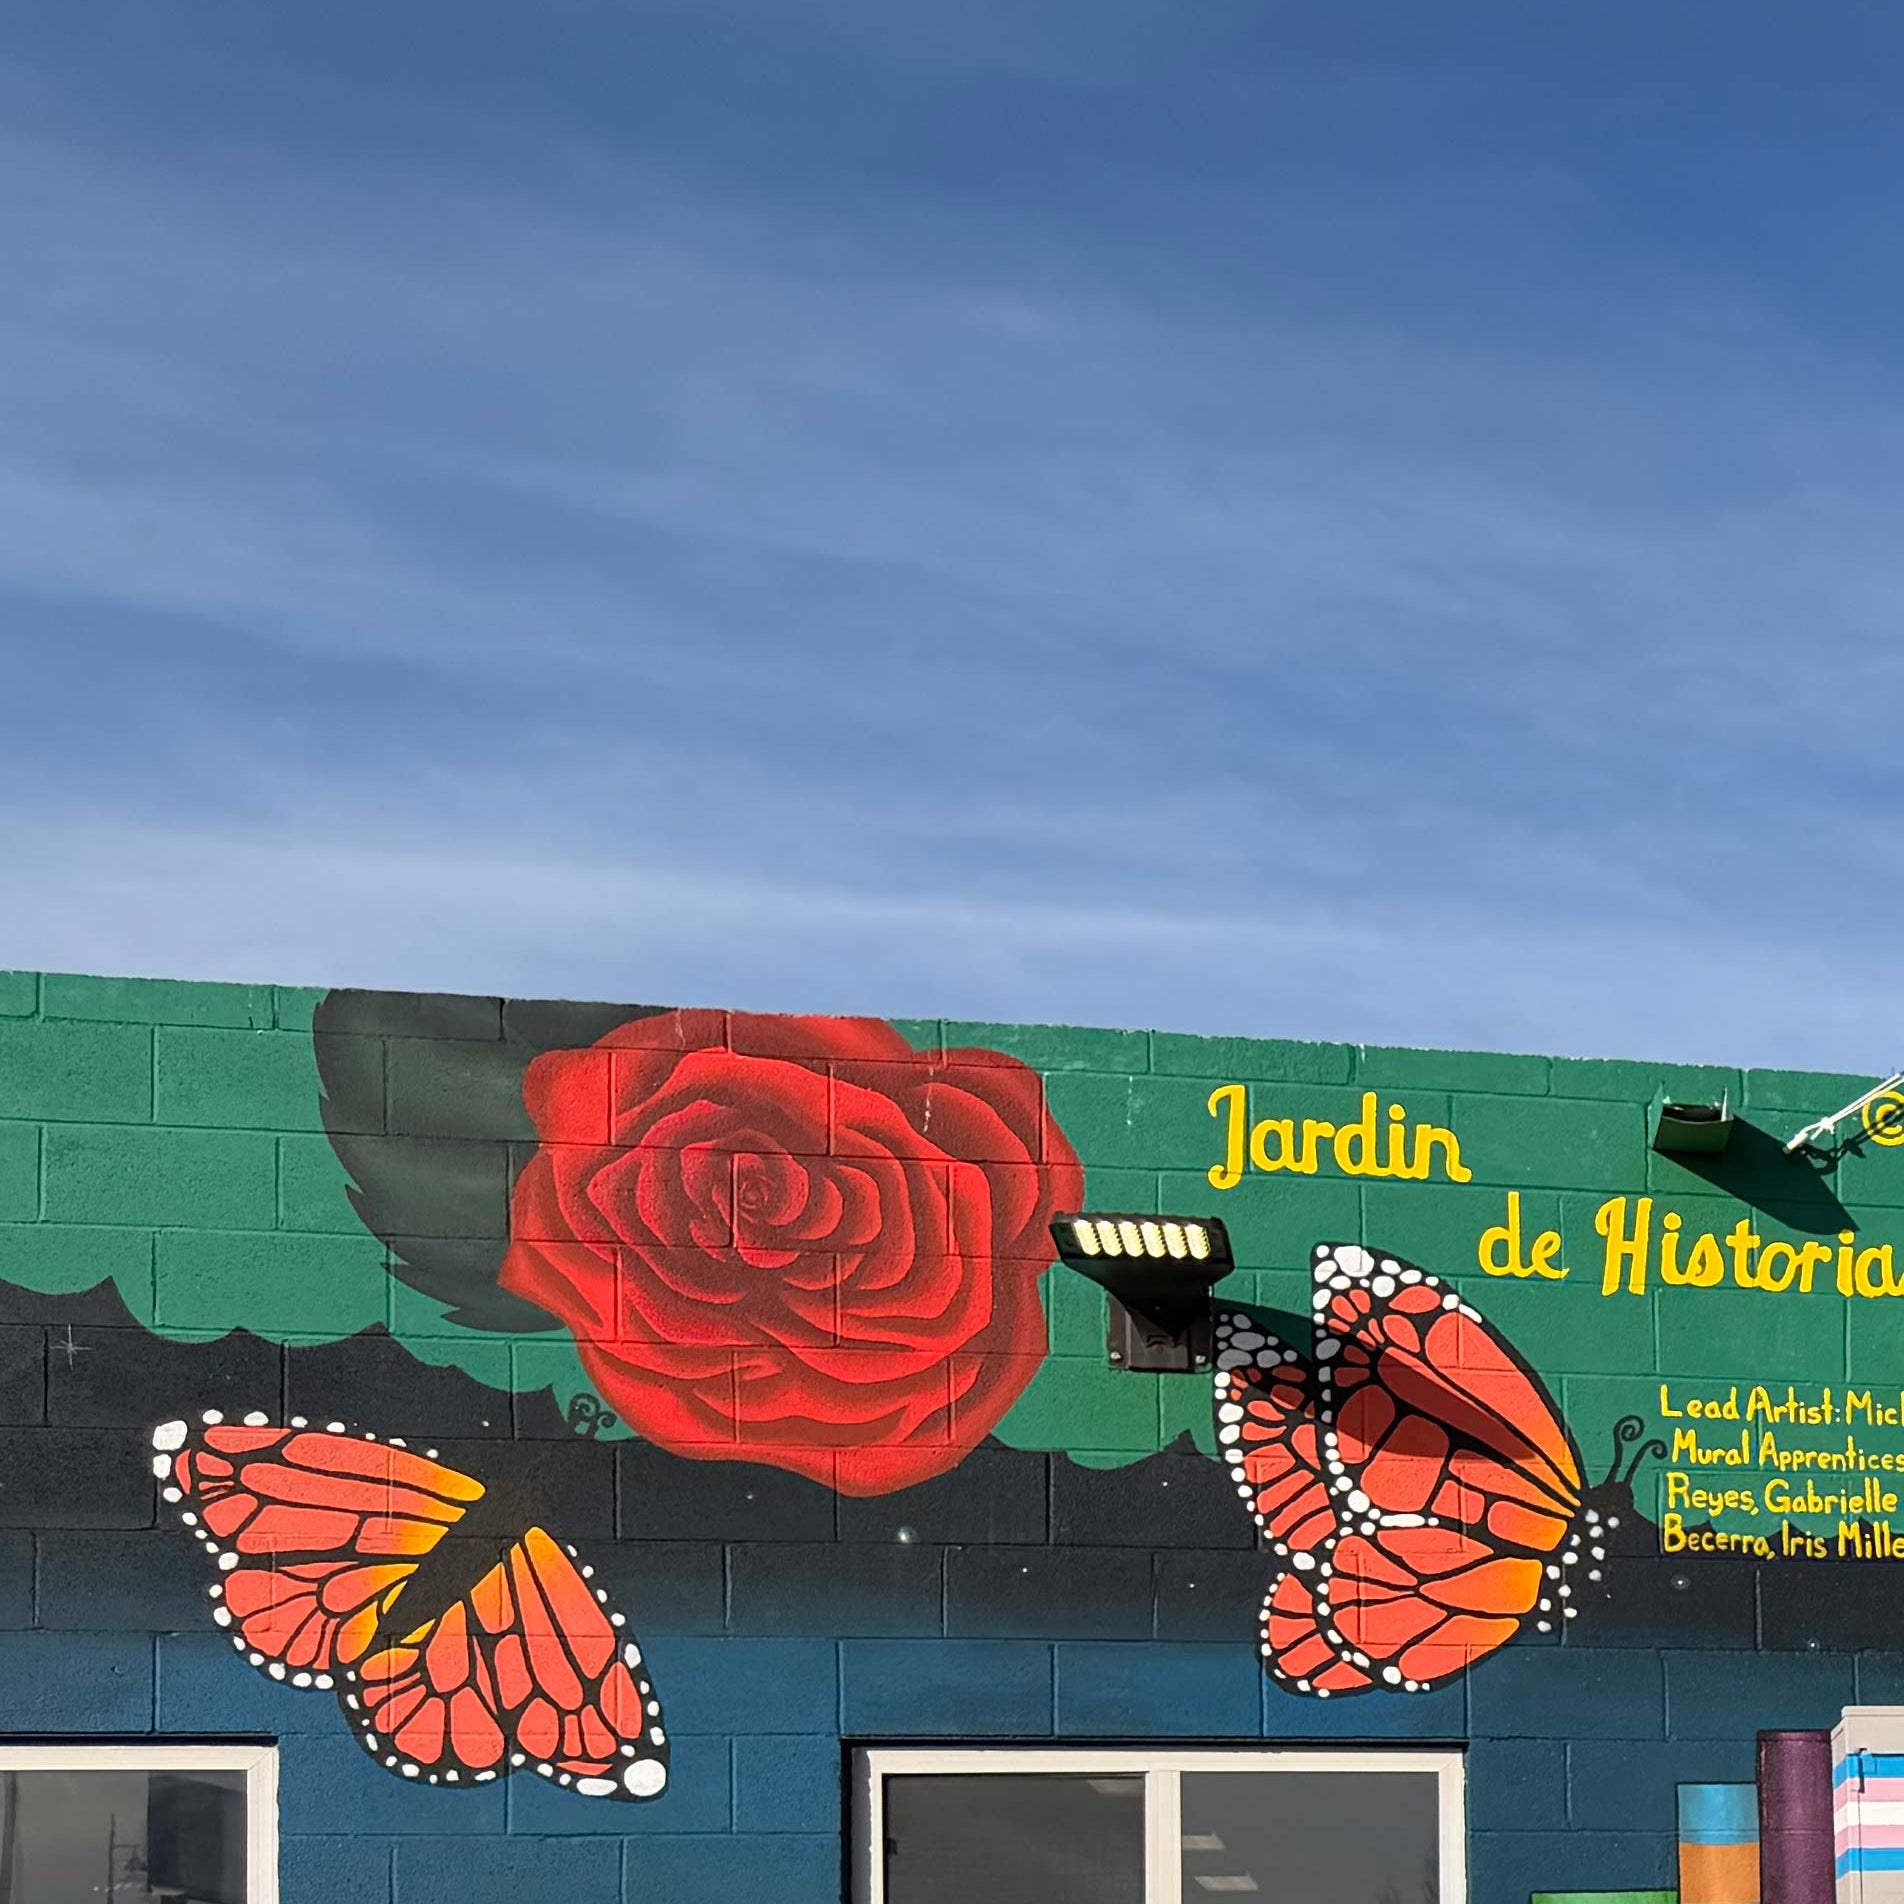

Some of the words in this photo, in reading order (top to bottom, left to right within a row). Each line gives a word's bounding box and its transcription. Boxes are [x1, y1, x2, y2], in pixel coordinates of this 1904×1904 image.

[1208, 1084, 1473, 1190] Jardin
[1478, 1191, 1570, 1280] de
[1660, 1384, 1738, 1425] Lead
[1745, 1386, 1842, 1425] Artist:
[1672, 1428, 1750, 1465] Mural
[1666, 1472, 1760, 1515] Reyes,
[1764, 1478, 1898, 1514] Gabrielle
[1663, 1512, 1777, 1560] Becerra,
[1781, 1520, 1827, 1559] Iris
